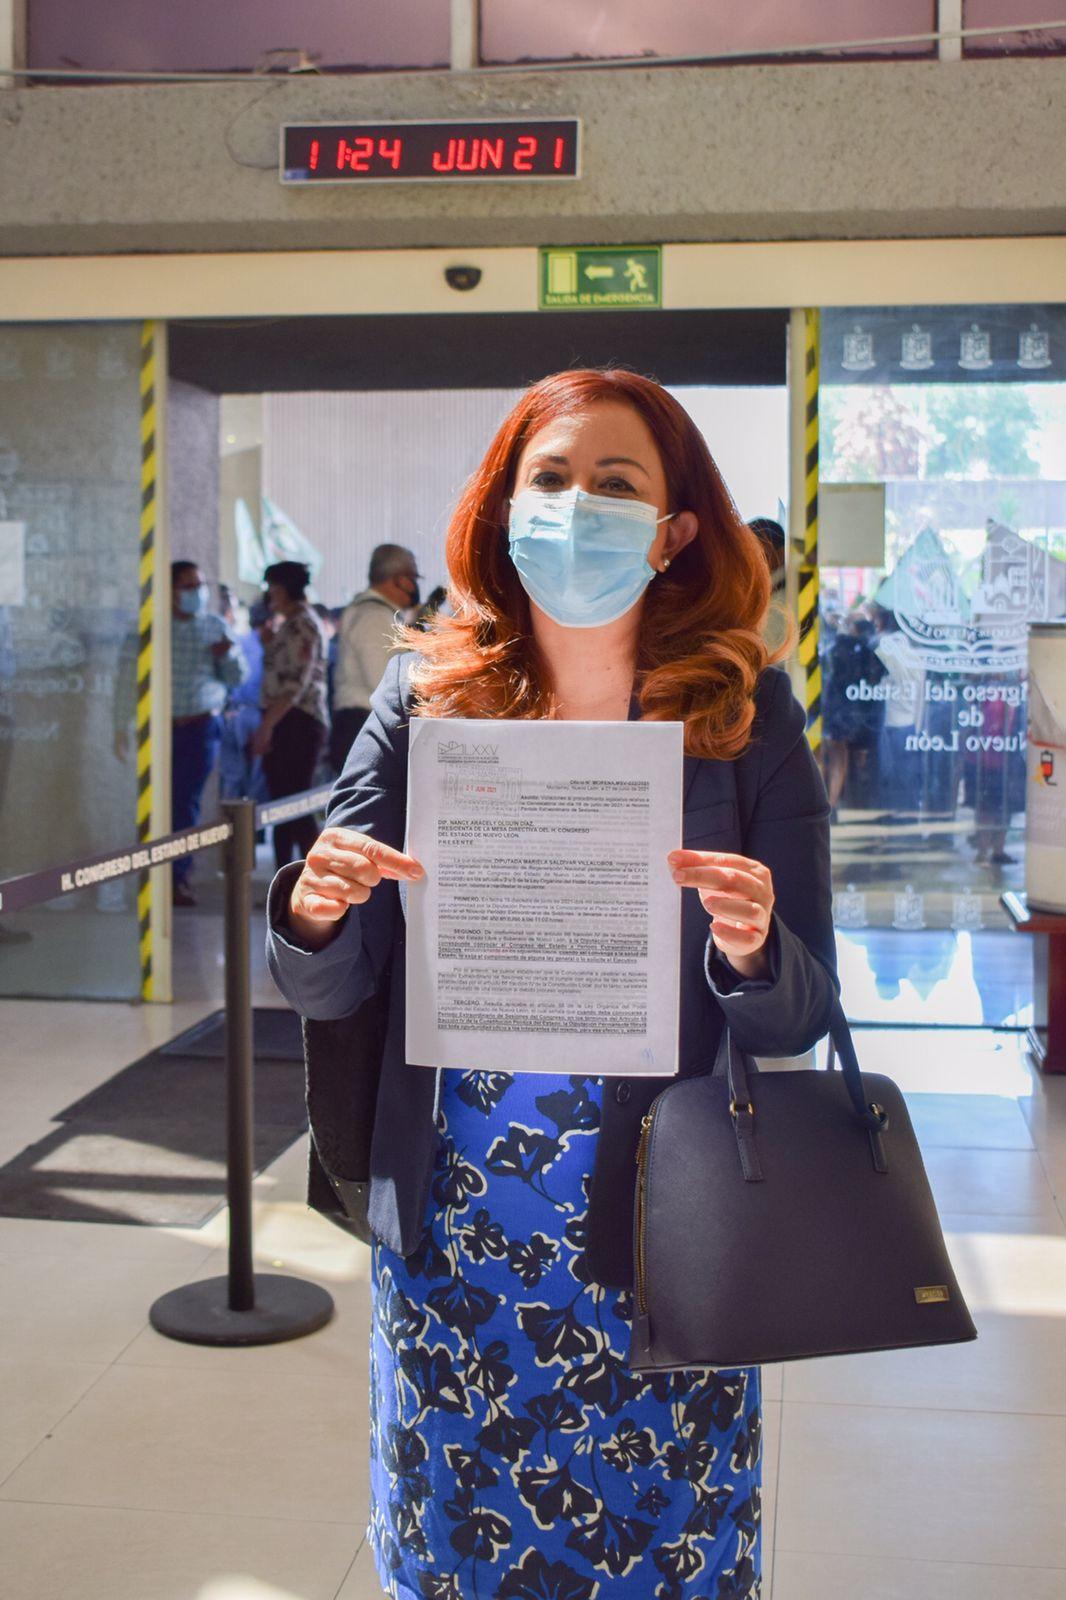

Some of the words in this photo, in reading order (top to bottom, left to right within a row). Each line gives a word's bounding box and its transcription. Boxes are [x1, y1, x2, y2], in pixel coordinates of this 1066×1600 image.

[432, 138, 504, 171] JUN
[513, 137, 564, 170] 21
[580, 294, 591, 304] DE
[464, 744, 499, 756] LXXV
[75, 855, 132, 888] CONGRESO
[131, 850, 151, 870] DEL
[151, 838, 187, 864] ESTADO
[187, 833, 200, 851] DE
